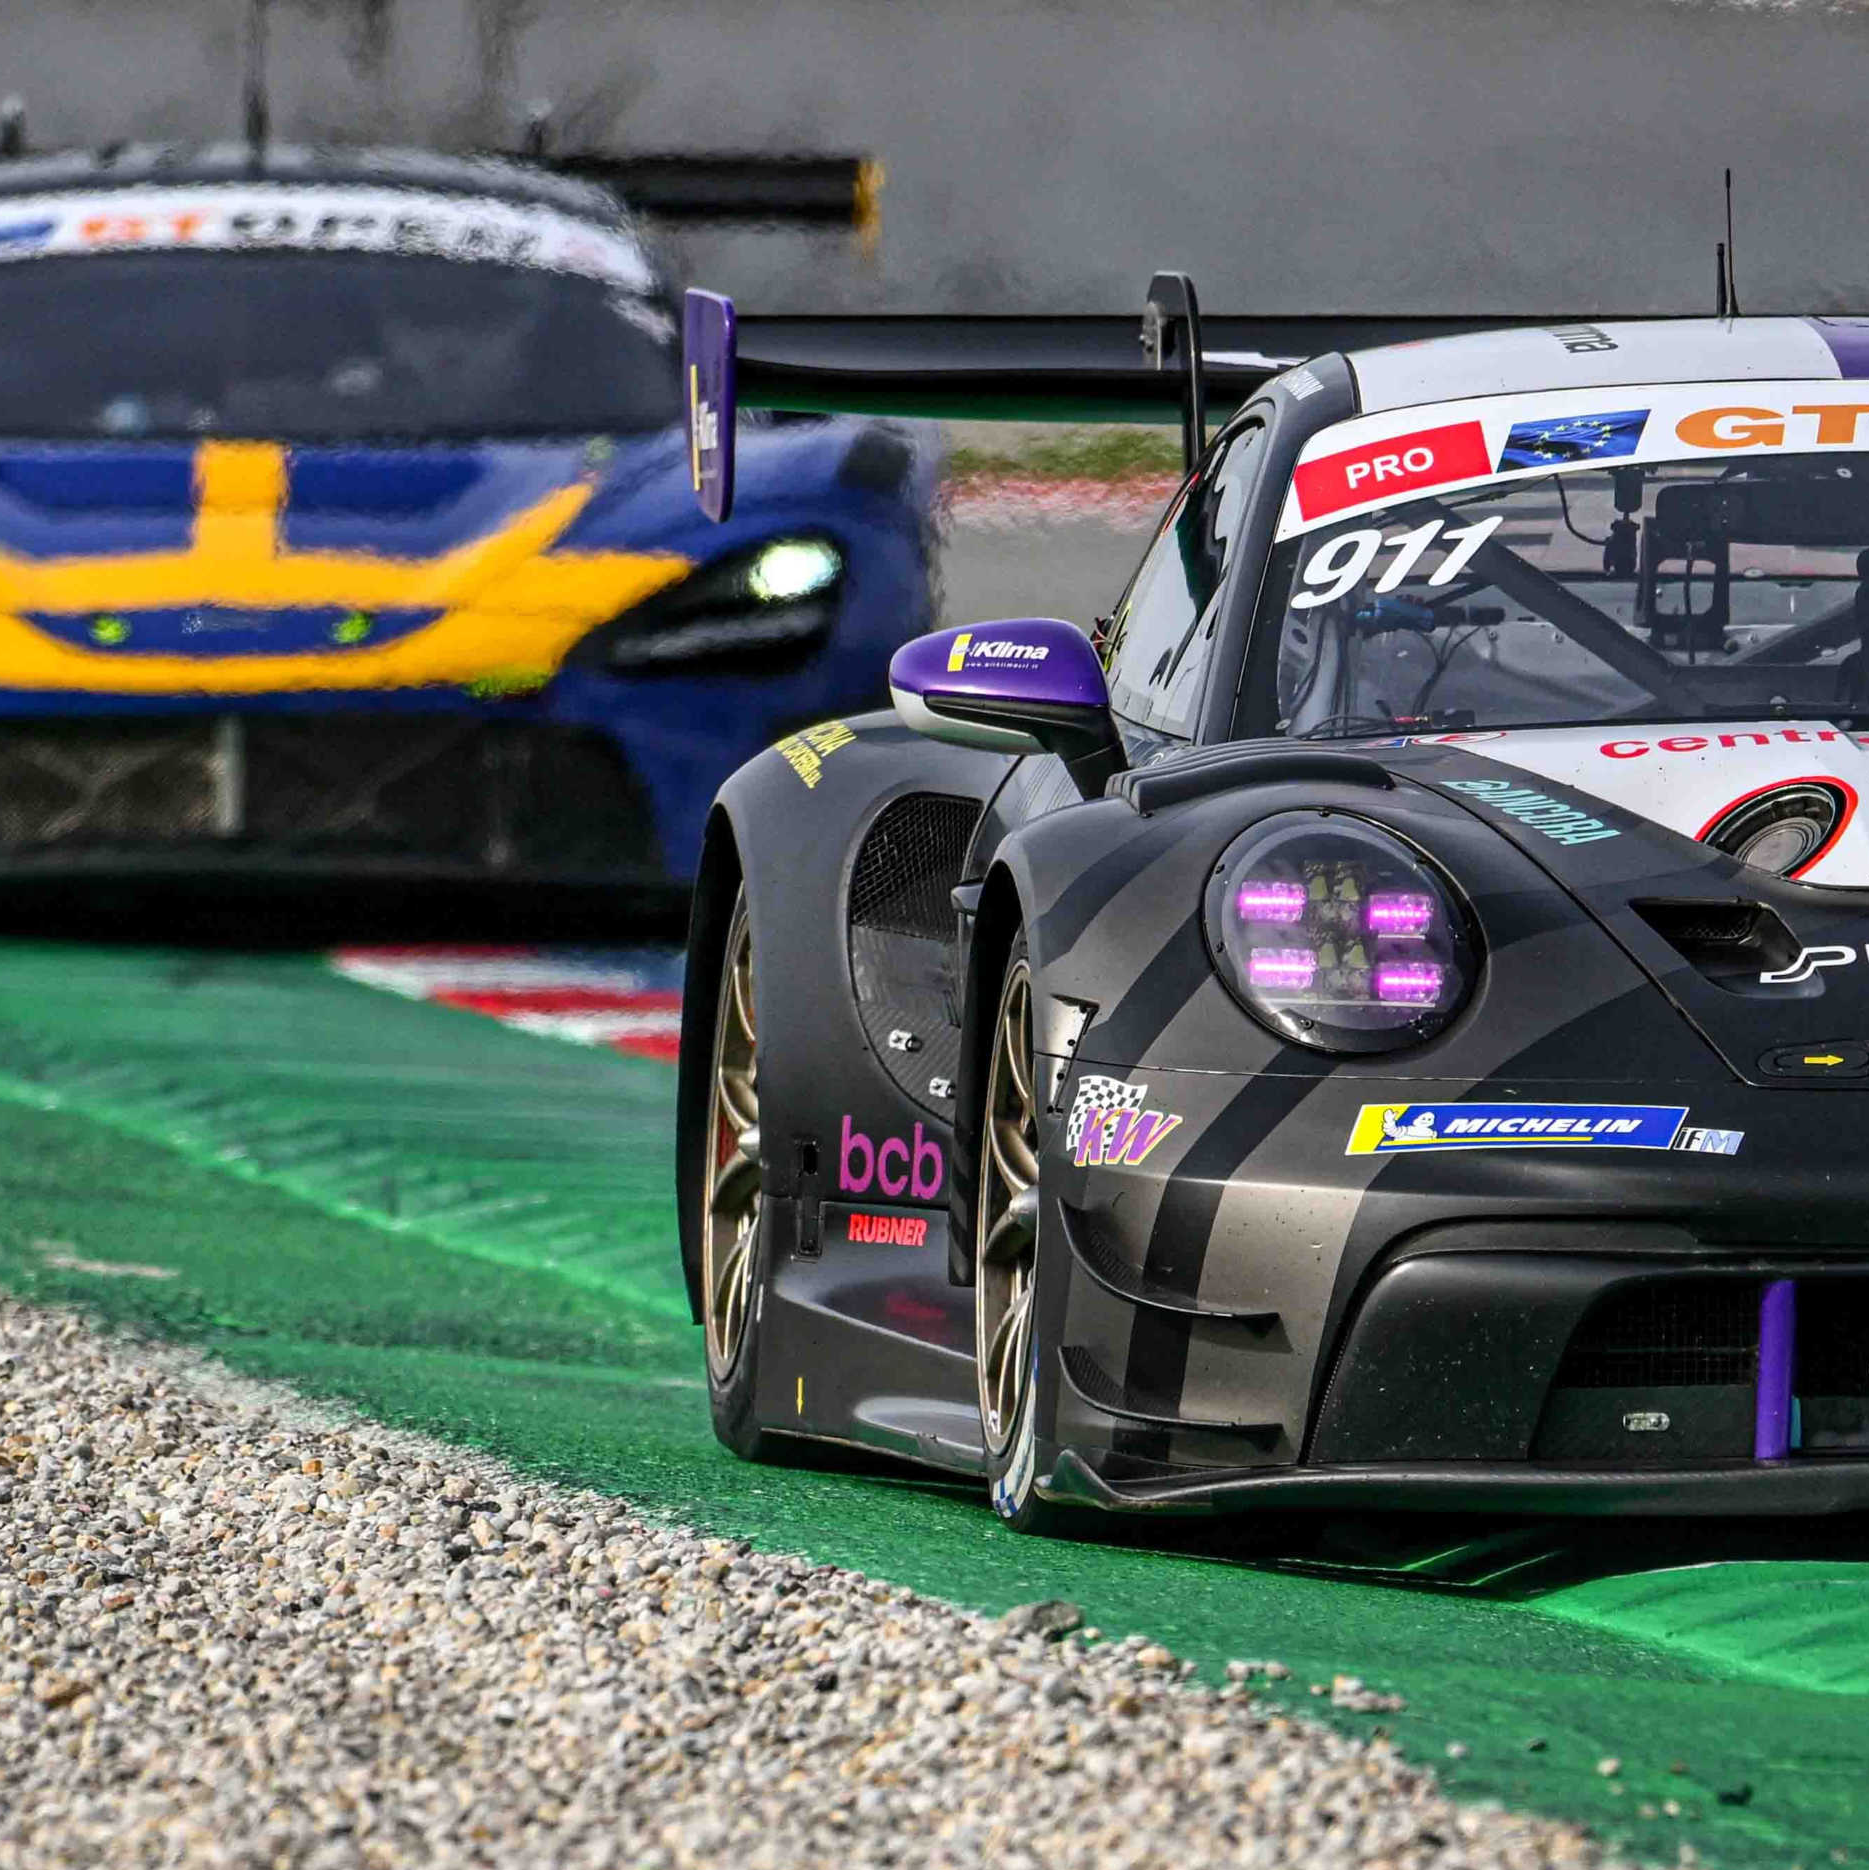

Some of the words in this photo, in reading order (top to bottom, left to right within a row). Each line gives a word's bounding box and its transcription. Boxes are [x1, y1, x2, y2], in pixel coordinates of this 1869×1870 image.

[1346, 446, 1435, 490] PRO
[1291, 515, 1504, 609] 911
[1074, 1106, 1183, 1167] KW
[1445, 1118, 1643, 1134] MICHELIN
[839, 1115, 943, 1199] bcb
[848, 1213, 928, 1247] RUBNER
